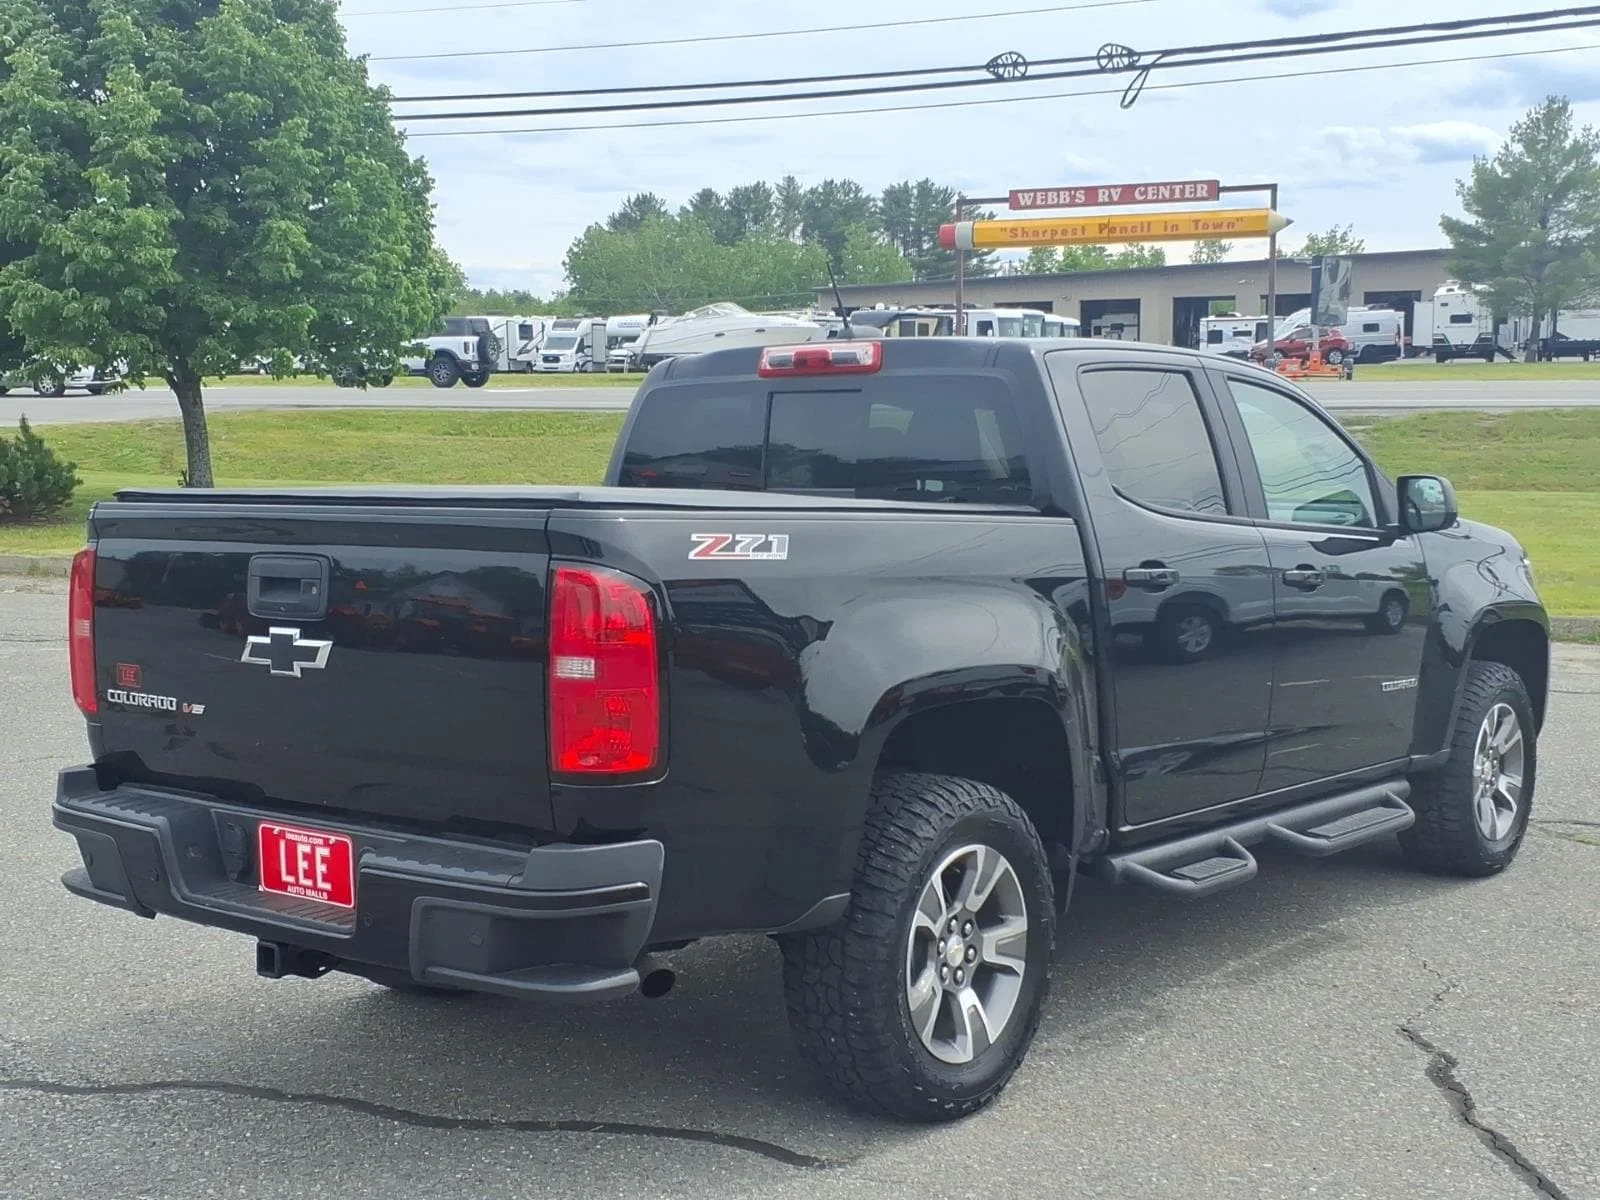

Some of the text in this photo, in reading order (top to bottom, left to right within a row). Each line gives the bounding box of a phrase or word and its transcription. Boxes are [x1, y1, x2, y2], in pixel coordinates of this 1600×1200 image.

[1017, 183, 1209, 206] WEBB'S RV CENTER
[1000, 217, 1244, 240] "Sharpest Pencil in Town"
[688, 533, 789, 560] Z71
[107, 689, 177, 711] COLORADO
[279, 838, 333, 892] LEE
[287, 884, 328, 900] AUTO MALLS
